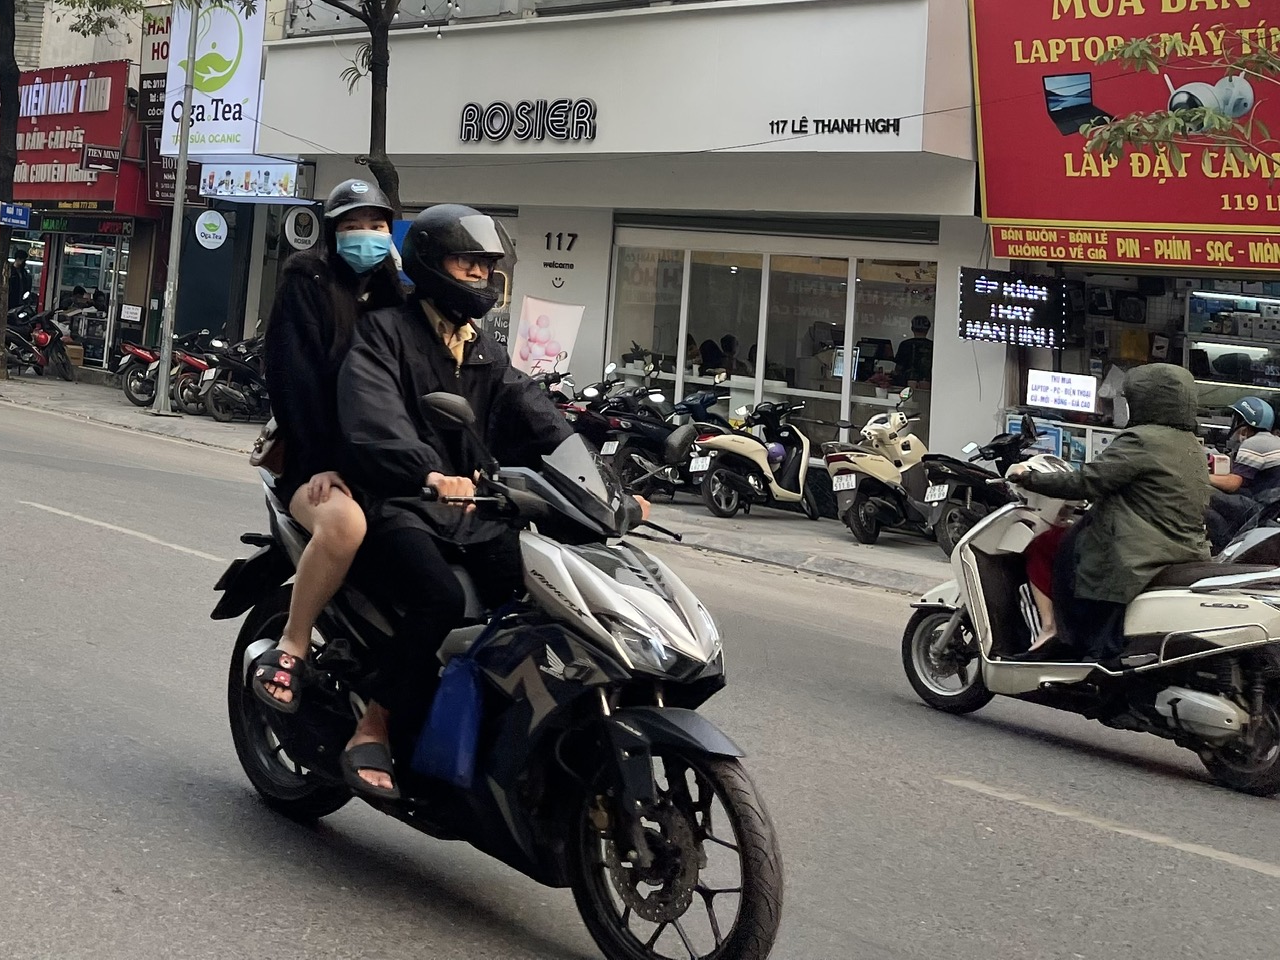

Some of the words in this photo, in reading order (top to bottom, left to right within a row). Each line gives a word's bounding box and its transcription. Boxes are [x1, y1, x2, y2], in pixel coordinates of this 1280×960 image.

[1159, 23, 1227, 58] MÁY
[211, 98, 243, 121] Tea
[459, 97, 597, 142] ROSIER
[768, 119, 788, 135] 117
[791, 116, 809, 135] LÊ
[813, 119, 861, 135] THANH
[865, 118, 900, 137] NGHỊ
[1220, 194, 1259, 211] 119
[545, 232, 578, 251] 117
[1000, 228, 1024, 241] BÁN
[1068, 229, 1092, 244] BÁN
[1008, 242, 1048, 258] KHÔNG
[1050, 246, 1066, 258] LO
[1086, 247, 1107, 260] GIÁ
[1116, 237, 1140, 258] PIN
[1154, 235, 1191, 260] PHÍM
[1206, 240, 1235, 267] SẠC
[543, 261, 574, 269] welcome
[1031, 384, 1049, 392] LAPTOP
